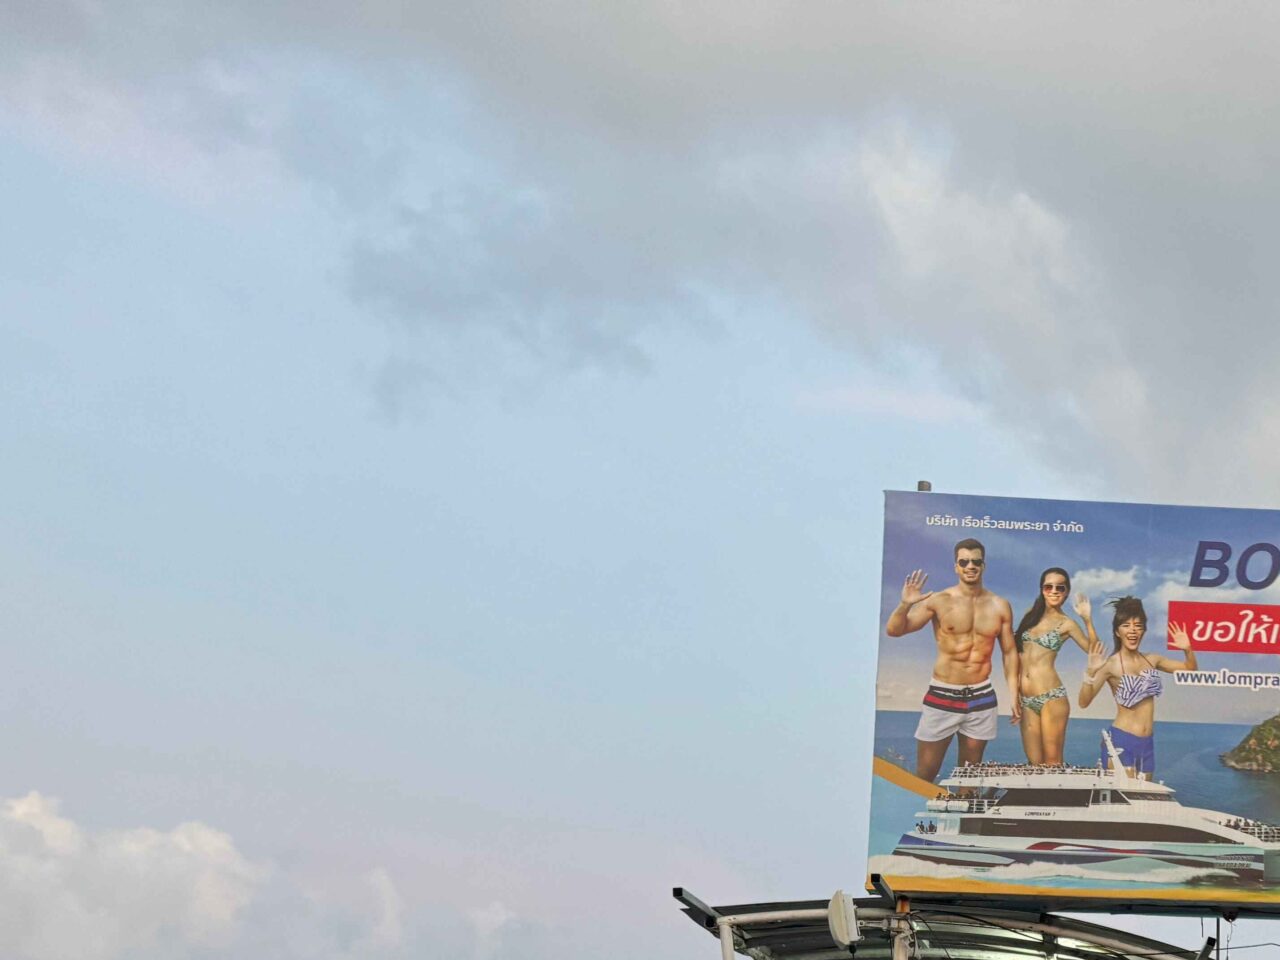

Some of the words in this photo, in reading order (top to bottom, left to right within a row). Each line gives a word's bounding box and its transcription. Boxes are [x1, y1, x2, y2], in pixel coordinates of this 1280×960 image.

[926, 514, 958, 527] บริษัท
[1052, 519, 1084, 533] จำกัด
